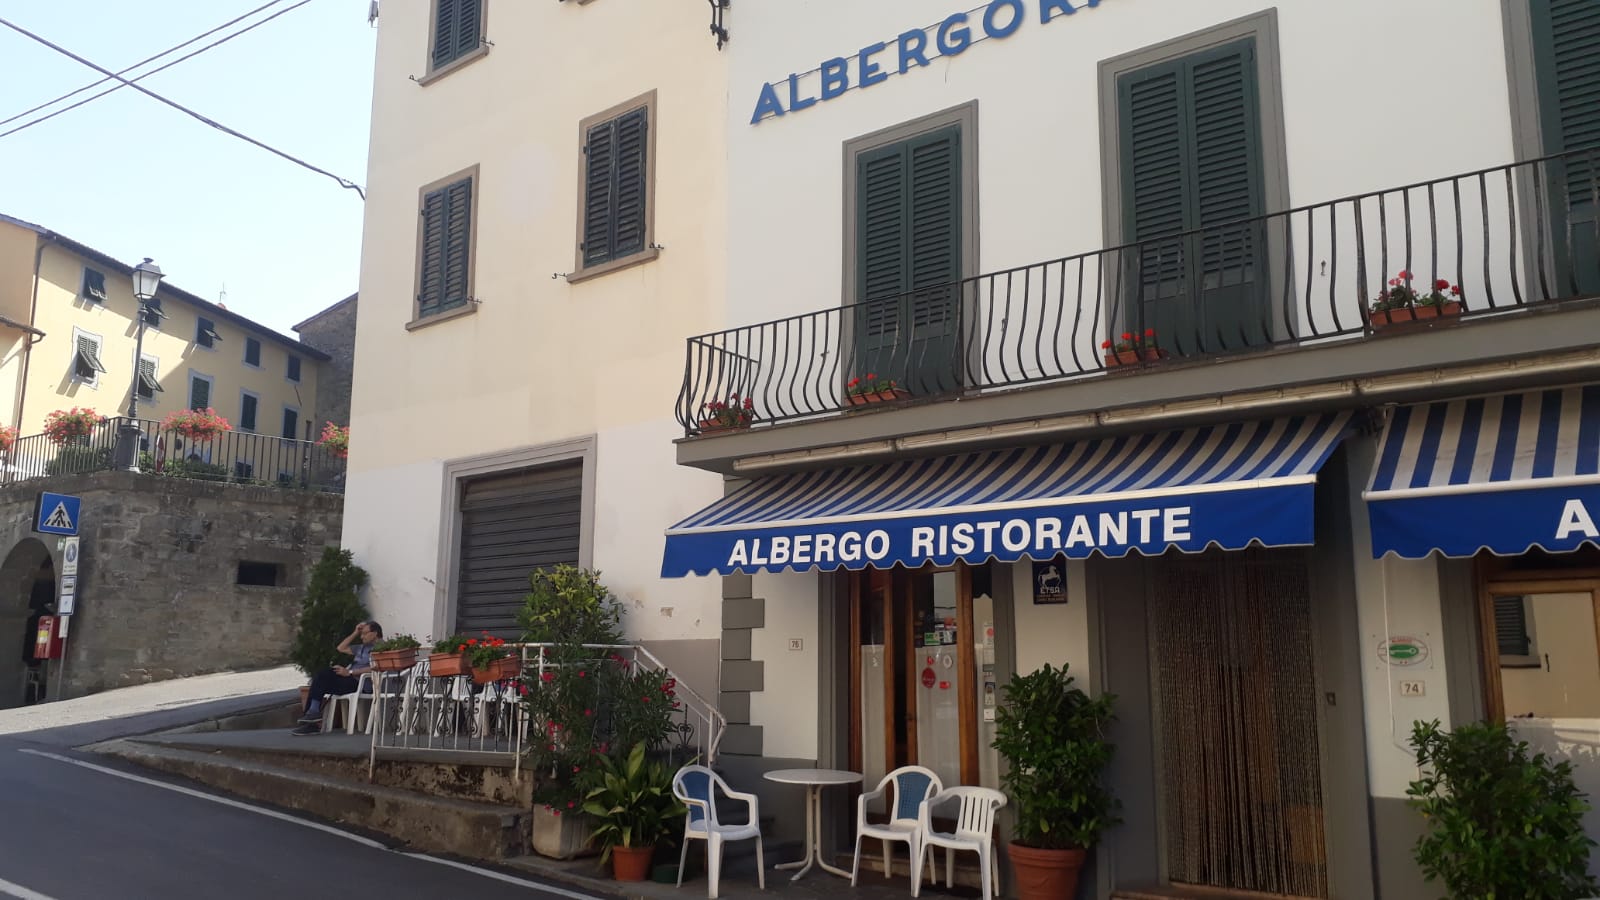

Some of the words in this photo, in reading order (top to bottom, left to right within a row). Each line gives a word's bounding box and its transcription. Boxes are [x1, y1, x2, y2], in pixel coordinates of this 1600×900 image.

[751, 0, 1024, 124] ALBERGO
[727, 529, 890, 566] ALBERGO
[911, 506, 1191, 558] RISTORANTE
[1404, 683, 1419, 694] 74
